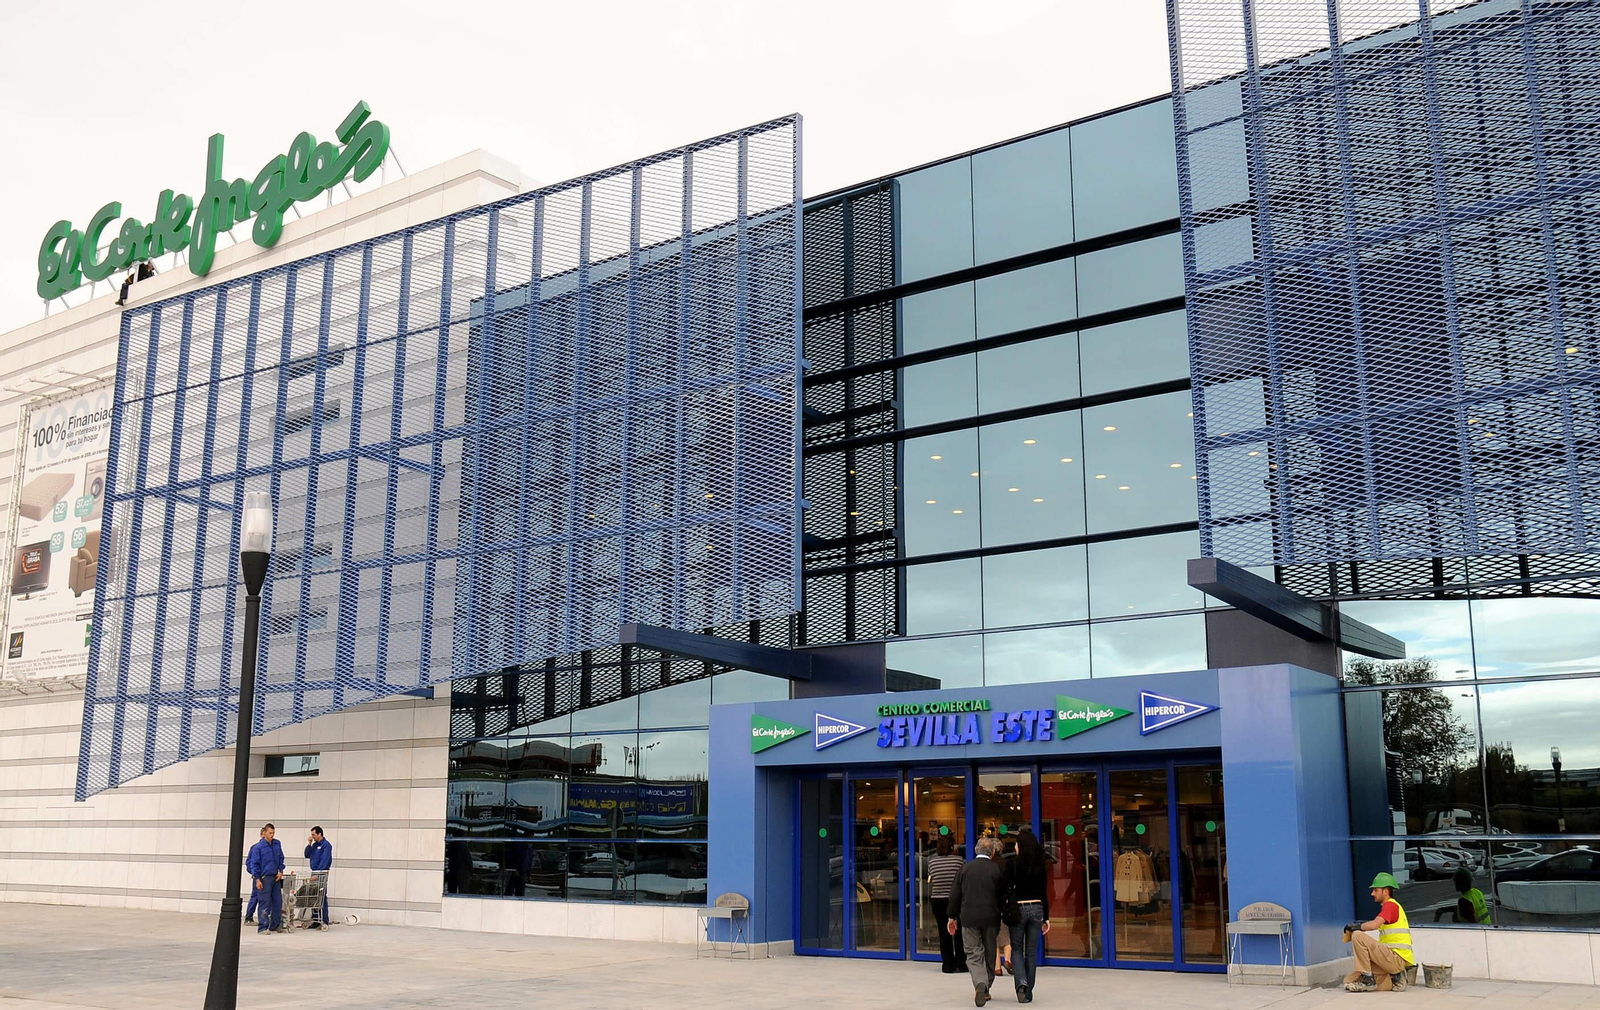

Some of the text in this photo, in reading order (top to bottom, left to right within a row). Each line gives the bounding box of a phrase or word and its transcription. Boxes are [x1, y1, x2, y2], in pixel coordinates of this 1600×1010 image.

[36, 99, 391, 301] El Corte Inglés
[32, 421, 67, 448] 100%
[65, 433, 99, 449] para tu hogar
[876, 699, 991, 717] CENTRO COMERCIAL
[1144, 704, 1186, 717] HIPERCOR
[1058, 708, 1114, 727] El Corte Inglés
[760, 727, 774, 737] Corte
[773, 724, 796, 739] Inglés
[818, 724, 850, 734] HIPERCOR
[876, 709, 1056, 749] SEVILLA ESTE
